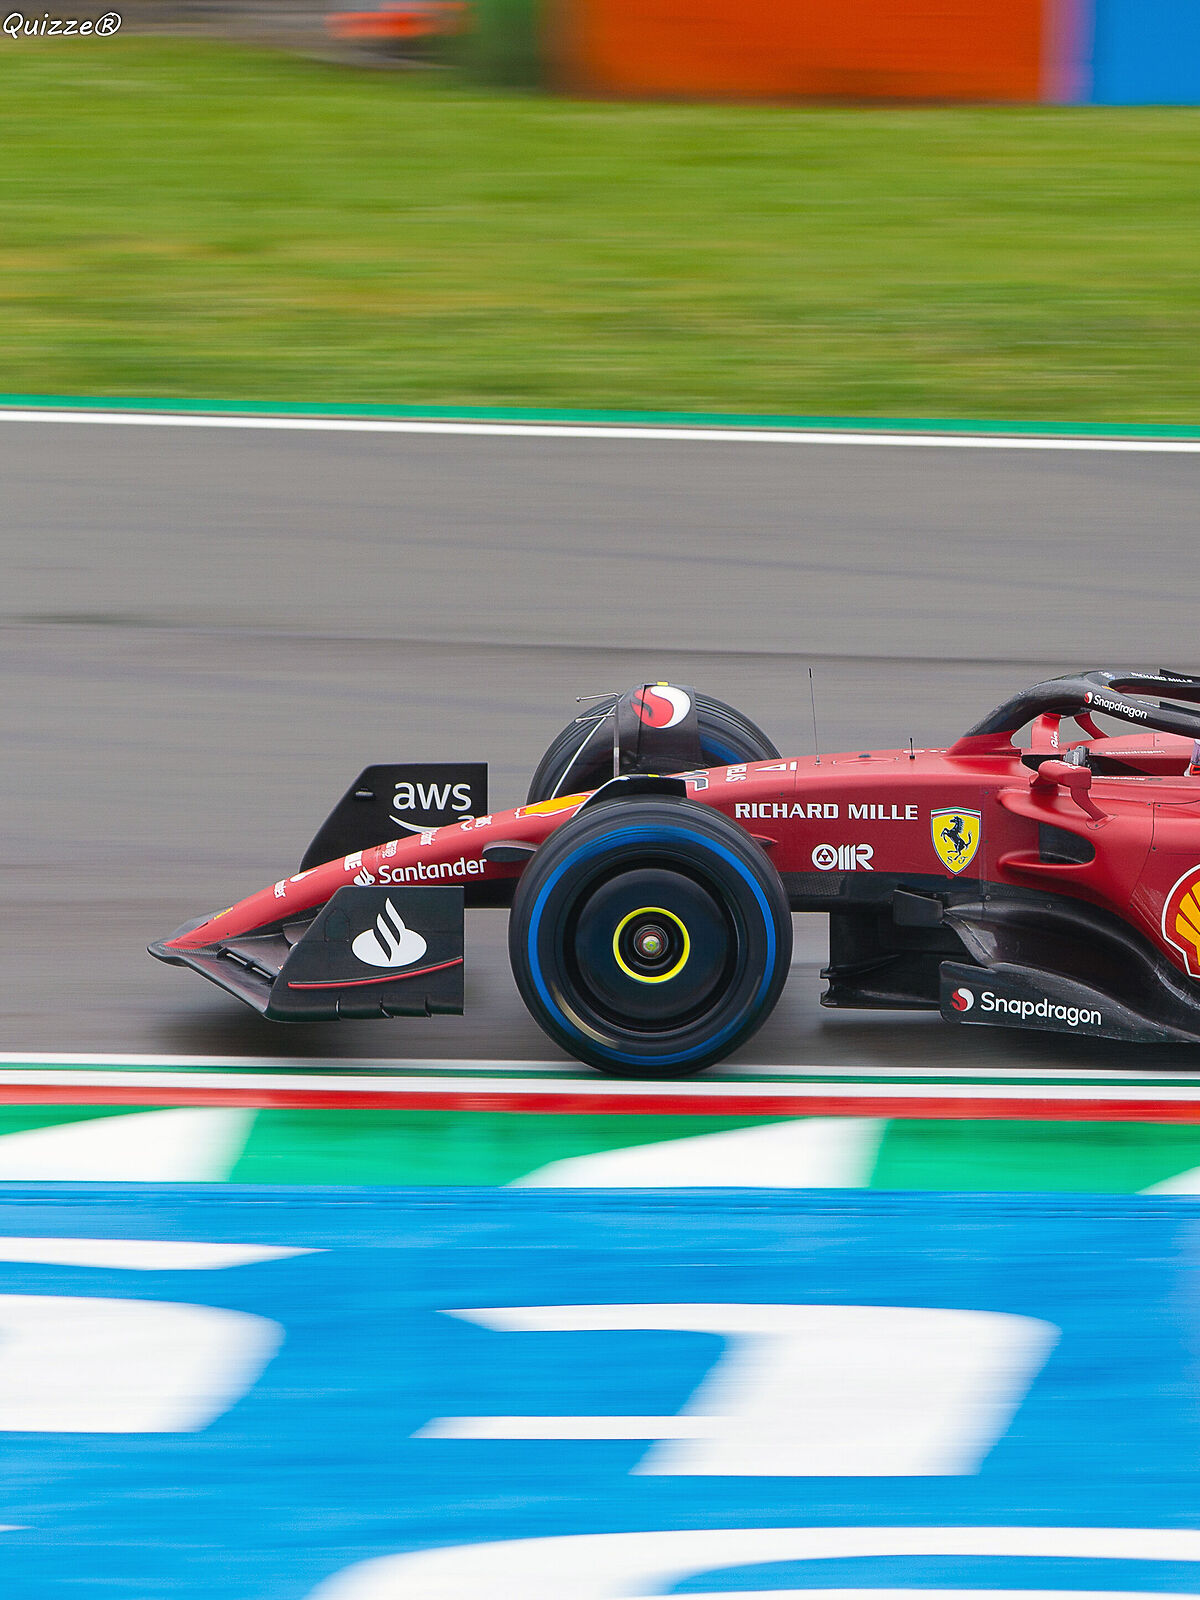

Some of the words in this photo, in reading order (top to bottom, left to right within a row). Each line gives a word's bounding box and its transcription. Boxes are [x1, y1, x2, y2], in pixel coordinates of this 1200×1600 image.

[1093, 694, 1148, 720] Snapdragon
[392, 781, 473, 812] aws
[735, 802, 839, 820] RICHARD
[847, 803, 918, 820] MILLE
[377, 856, 487, 885] Santander
[980, 991, 1103, 1027] Snapdragon
